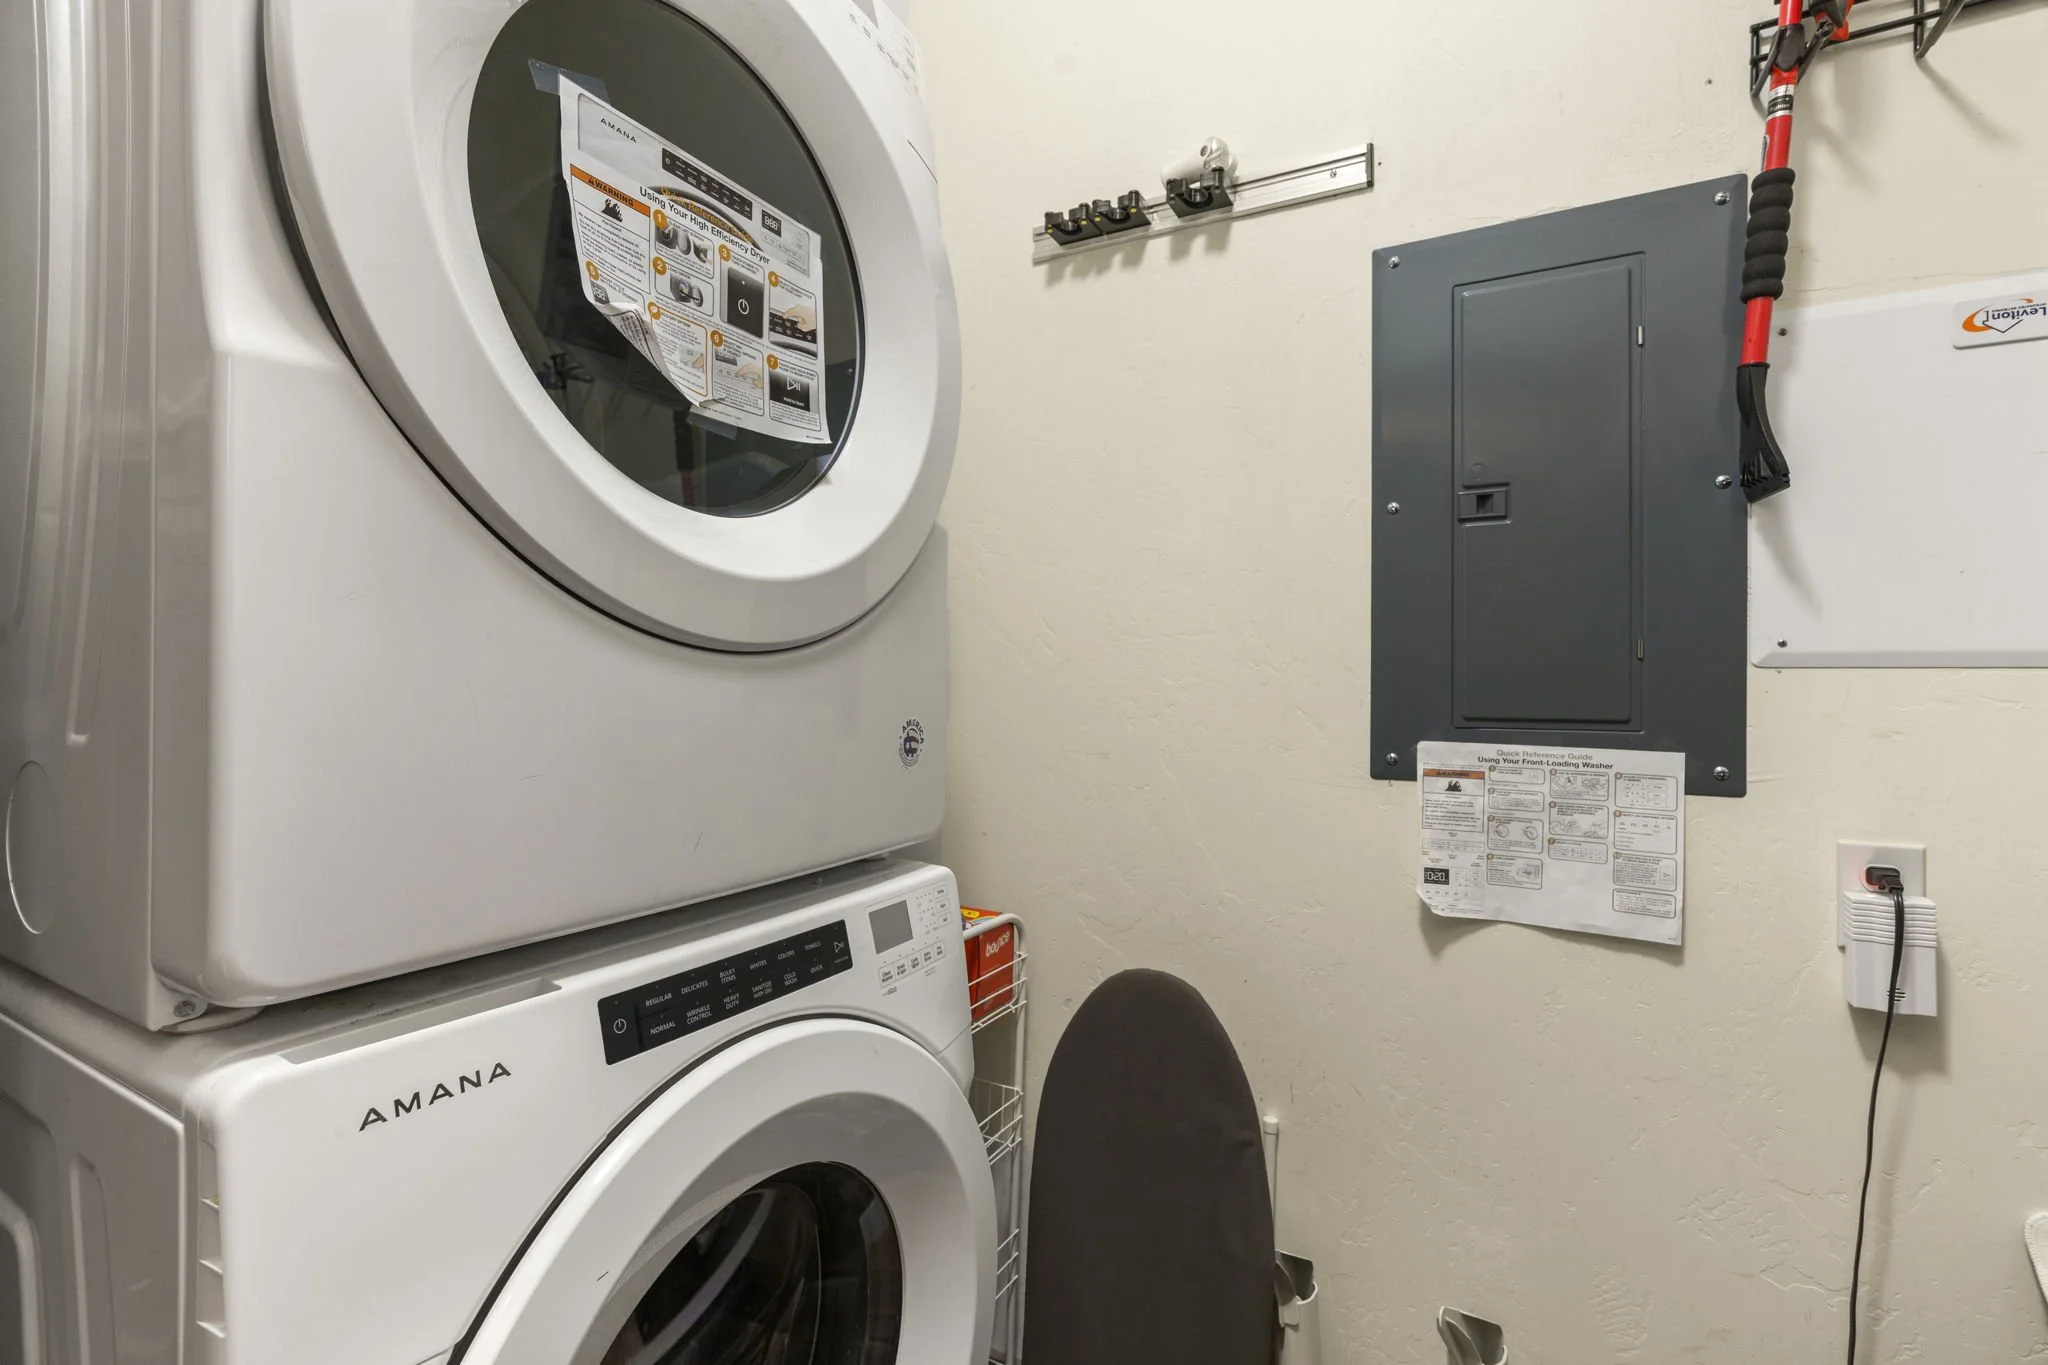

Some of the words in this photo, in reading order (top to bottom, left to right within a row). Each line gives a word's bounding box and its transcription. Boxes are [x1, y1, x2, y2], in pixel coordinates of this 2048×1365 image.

[600, 118, 637, 144] AMANA
[595, 181, 634, 206] WARNING
[640, 186, 666, 210] Using
[668, 202, 688, 220] Your
[690, 214, 709, 232] High
[711, 224, 748, 253] Efficiency
[750, 247, 770, 264] Dryer
[1991, 306, 2047, 320] Leviton
[1522, 750, 1565, 759] Reference
[1478, 756, 1500, 764] Using
[1522, 759, 1579, 768] Front-Loading
[986, 931, 1010, 958] bounce
[778, 950, 795, 960] COLORS
[749, 959, 768, 970] WHITES
[810, 964, 824, 974] QUICK
[720, 968, 736, 978] BULKY
[721, 974, 736, 984] ITEMS
[784, 972, 797, 980] COLD
[681, 980, 708, 994] DELICATES
[752, 980, 772, 993] SANITIZE
[645, 992, 673, 1006] REGULAR
[724, 993, 740, 1004] HEAVY
[726, 1000, 740, 1010] DUTY
[686, 1004, 711, 1018] WRINKLE
[686, 1012, 712, 1025] CONTROL
[650, 1021, 676, 1035] NORMAL
[358, 1062, 512, 1132] AMANA
